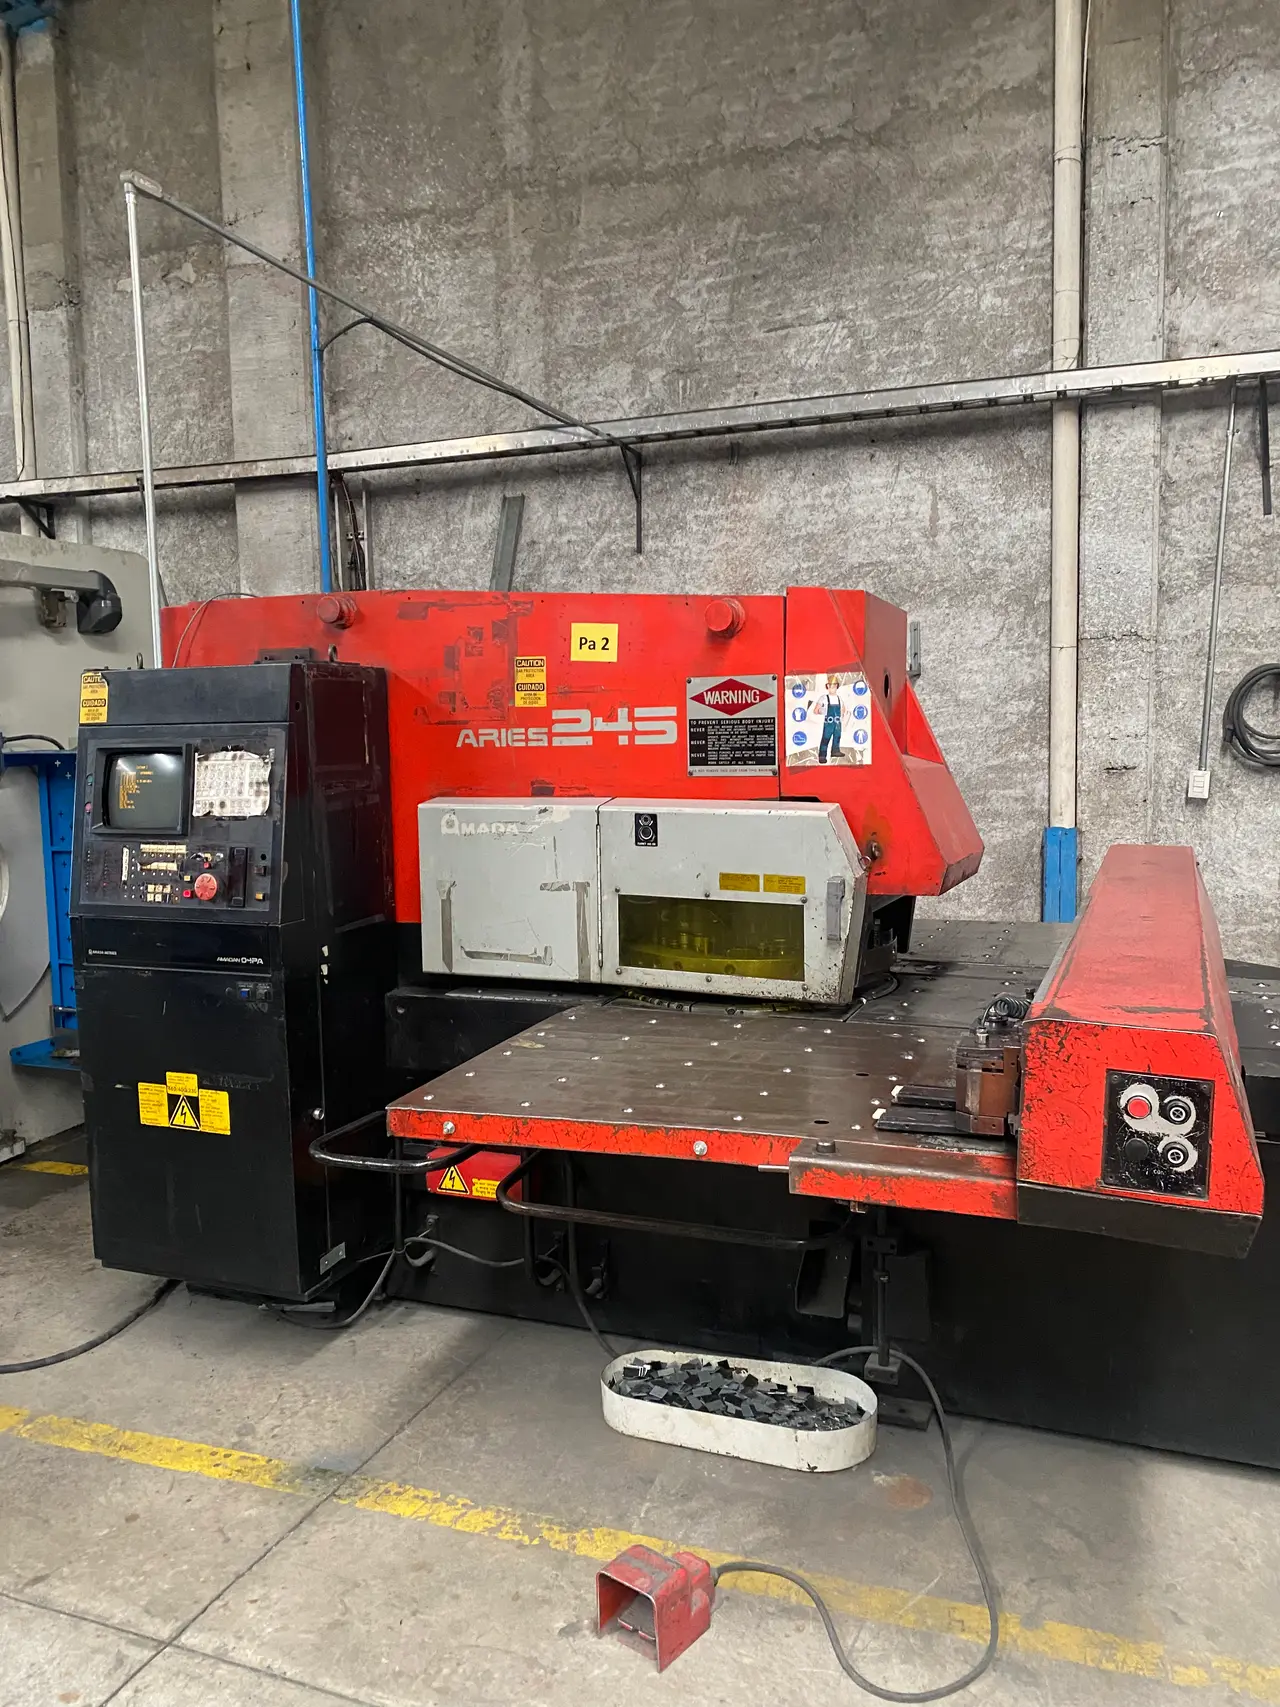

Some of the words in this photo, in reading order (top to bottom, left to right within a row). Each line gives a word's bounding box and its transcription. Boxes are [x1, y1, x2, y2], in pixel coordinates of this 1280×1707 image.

[579, 636, 596, 650] Pa
[601, 637, 610, 650] 2
[516, 659, 544, 667] CAUTION
[517, 683, 544, 691] CUIDADO
[703, 690, 760, 704] WARNING
[456, 727, 549, 748] ARIES
[552, 706, 678, 747] 245
